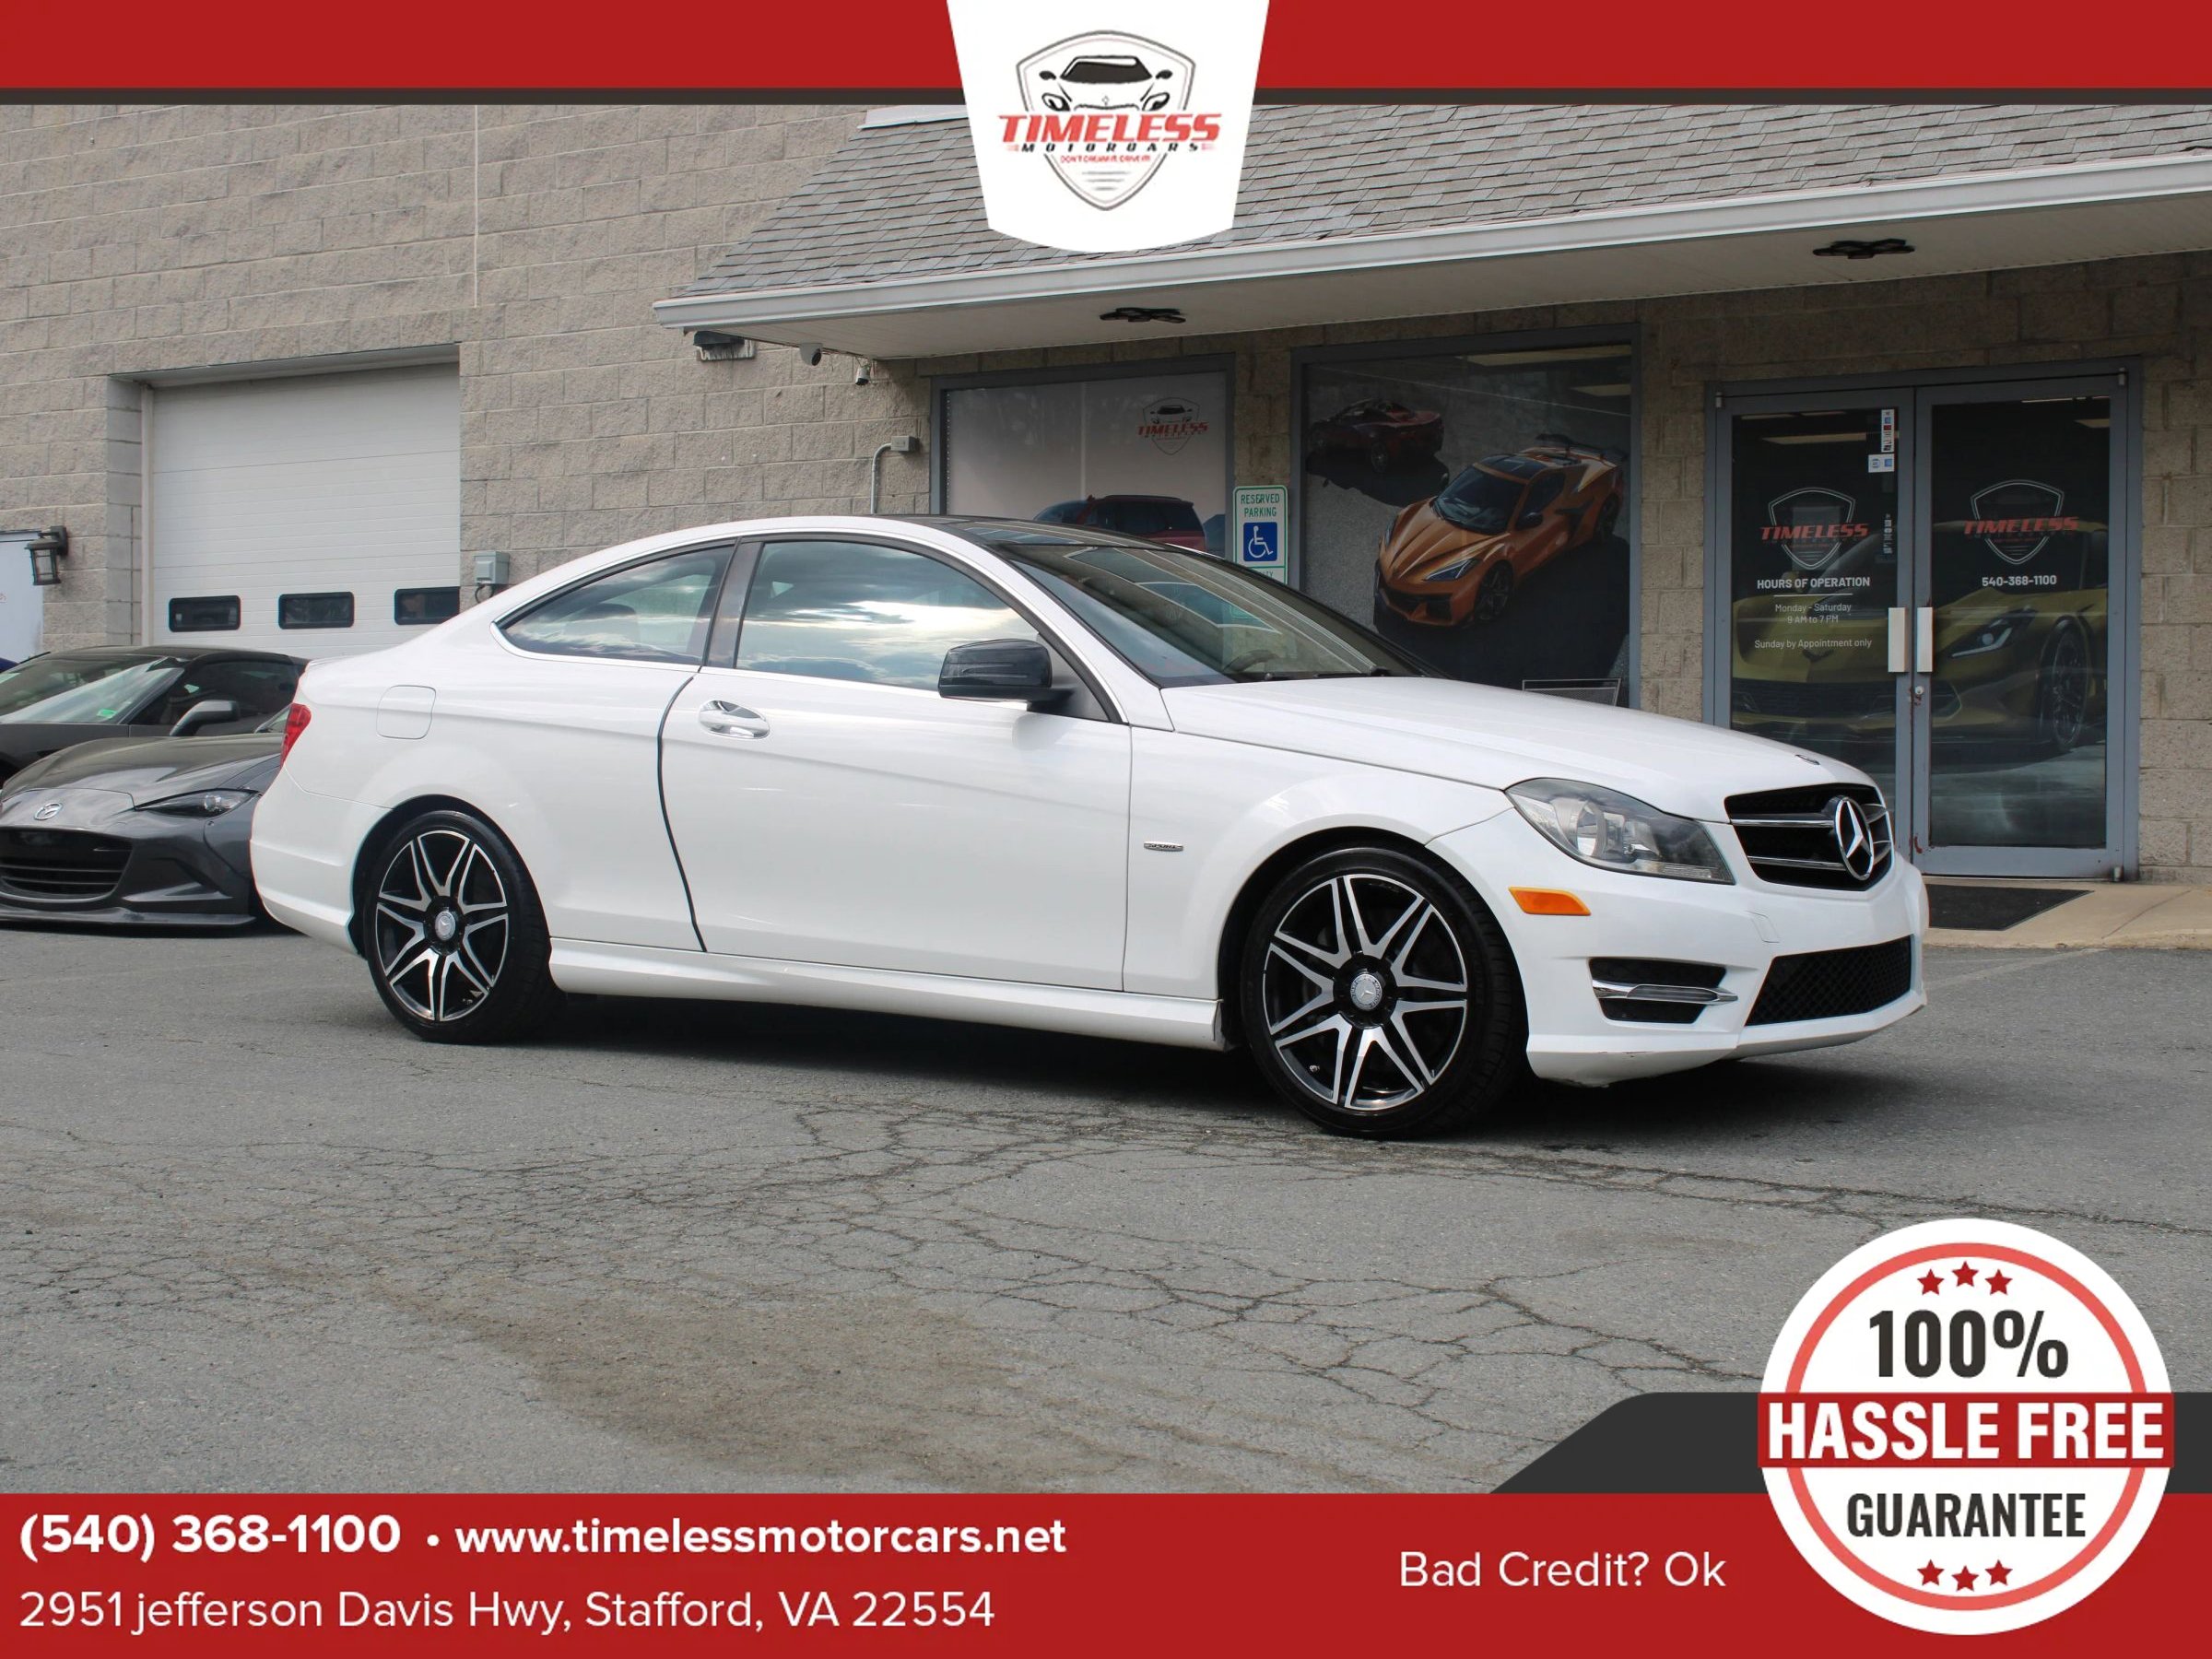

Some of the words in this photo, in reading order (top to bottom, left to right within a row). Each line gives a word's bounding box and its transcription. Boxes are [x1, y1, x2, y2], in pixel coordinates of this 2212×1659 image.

[1241, 493, 1280, 505] RESERVED
[1244, 507, 1277, 518] PARKING
[1760, 523, 1869, 540] TIMELESS
[1963, 516, 2080, 535] TIMELESS
[1757, 579, 1793, 590] HOURS
[1794, 578, 1807, 589] OF
[1810, 577, 1871, 589] OPERATION
[1982, 574, 2057, 587] 540-368-1100
[1775, 604, 1806, 614] Monday
[1813, 603, 1852, 613] Saturday
[1794, 615, 1807, 623] AM
[1819, 615, 1824, 623] 7
[1826, 614, 1839, 623] PM
[1754, 640, 1785, 649] Sunday
[1786, 640, 1796, 649] by
[1798, 639, 1853, 649] Appointment
[1853, 639, 1872, 648] only
